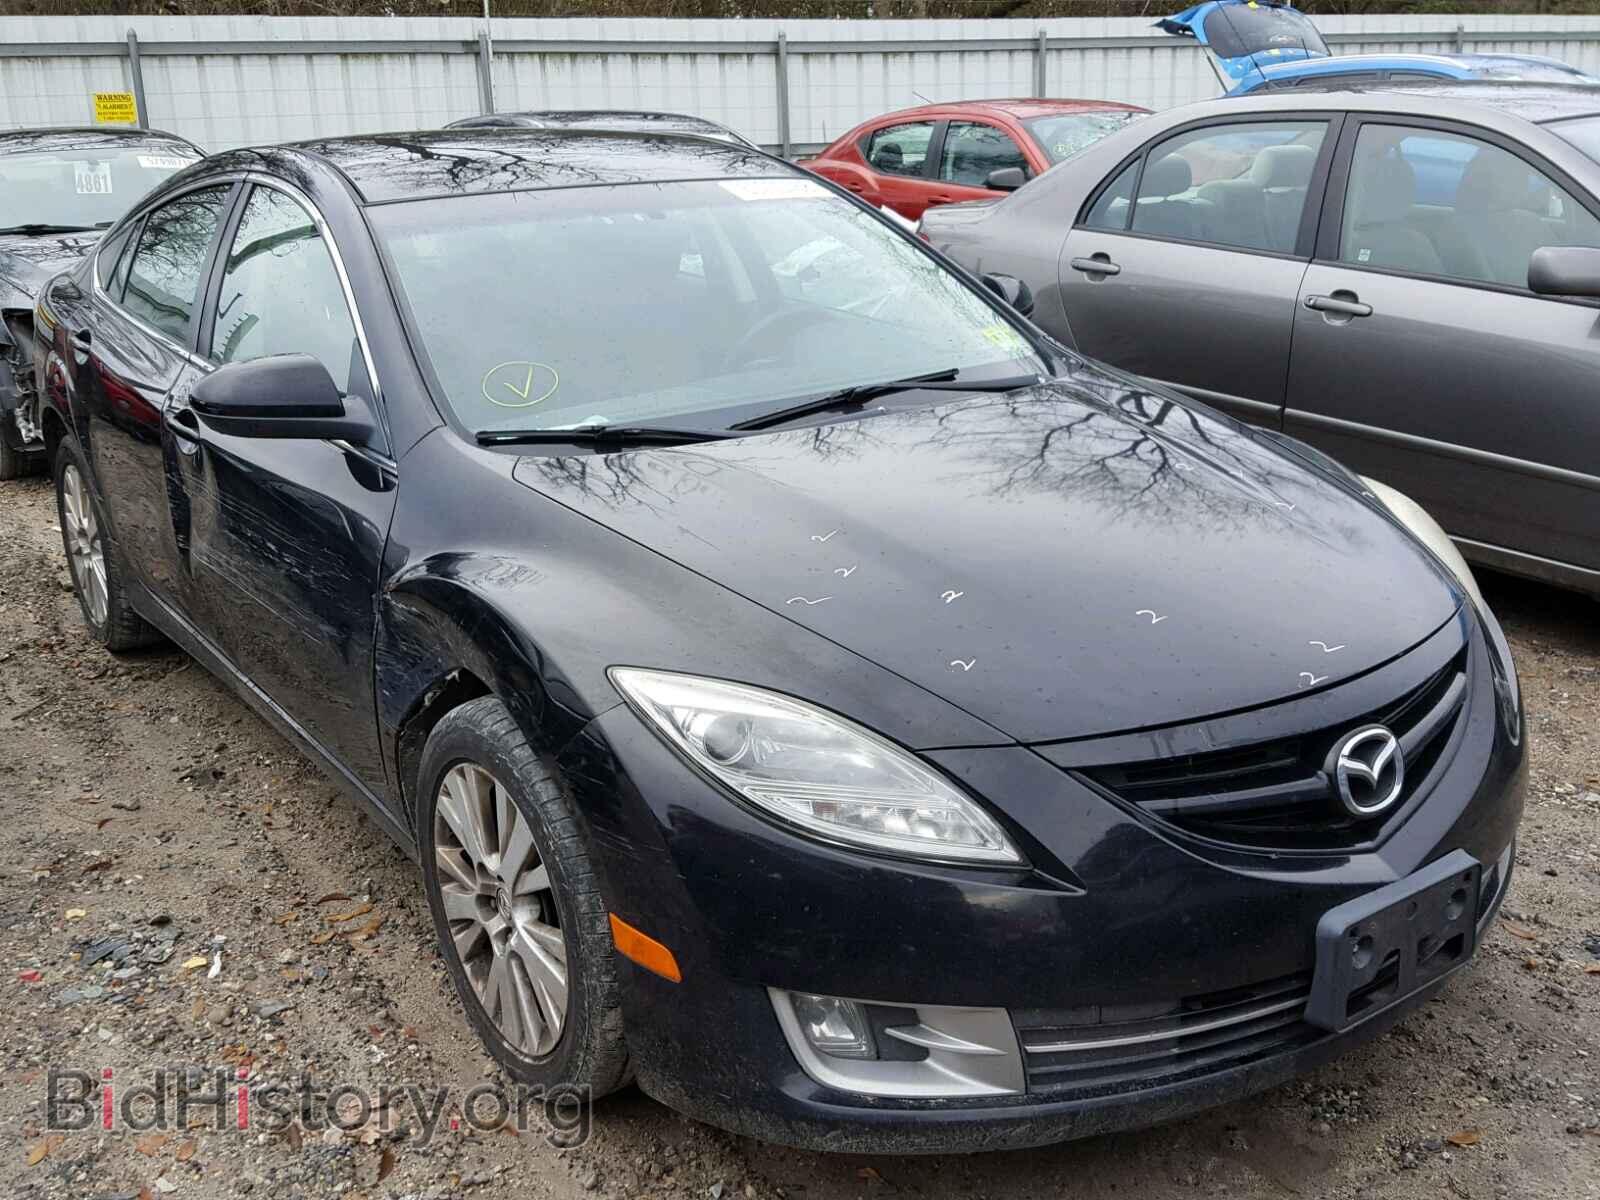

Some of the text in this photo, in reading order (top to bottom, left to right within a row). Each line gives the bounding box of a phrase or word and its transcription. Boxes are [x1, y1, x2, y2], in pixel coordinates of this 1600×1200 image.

[1135, 609, 1168, 624] 2
[950, 659, 977, 671] 2
[1298, 671, 1329, 686] 2
